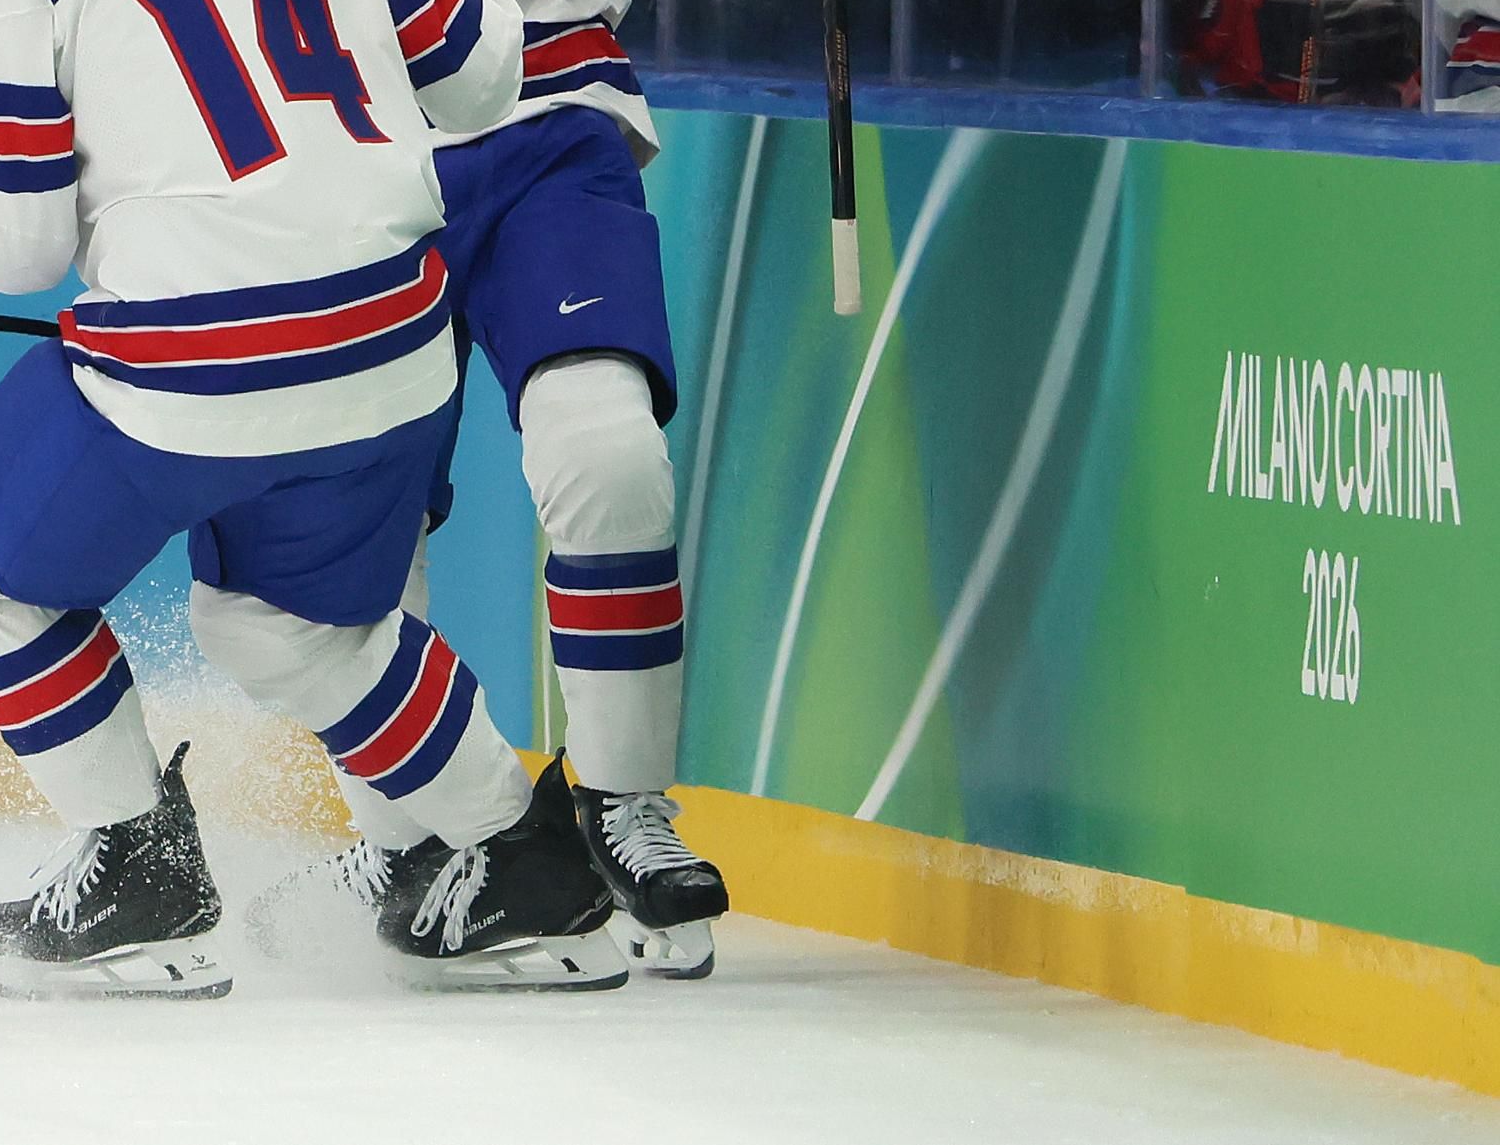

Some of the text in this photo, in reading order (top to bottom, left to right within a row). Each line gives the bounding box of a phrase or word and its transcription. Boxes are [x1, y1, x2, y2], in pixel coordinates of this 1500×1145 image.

[1208, 350, 1461, 526] MILANO CORTINA
[1301, 548, 1361, 705] 2026
